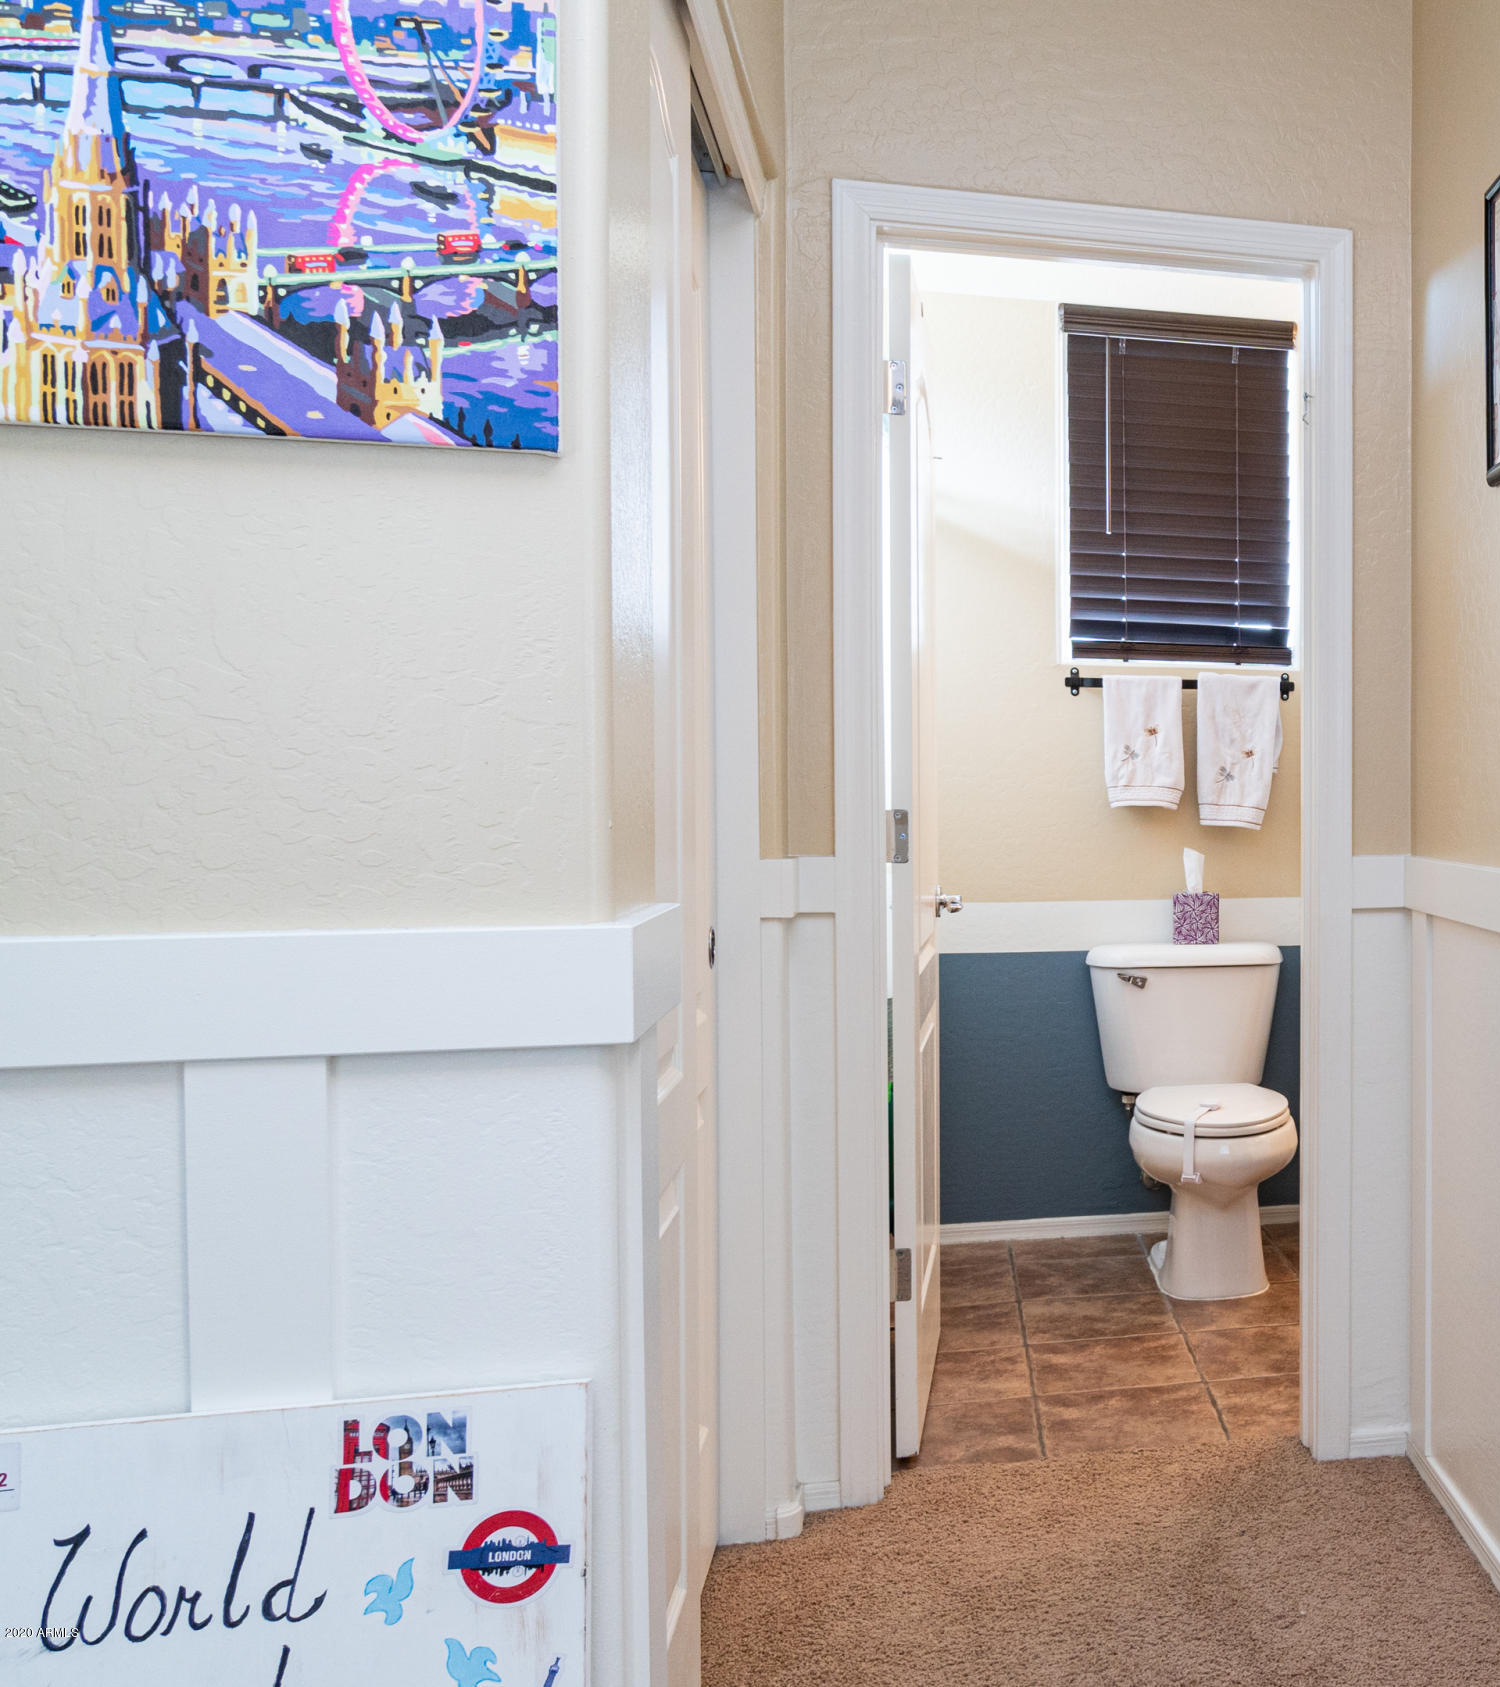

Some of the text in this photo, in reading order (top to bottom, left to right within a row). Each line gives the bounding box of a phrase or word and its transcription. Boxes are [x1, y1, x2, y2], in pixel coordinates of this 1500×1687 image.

[343, 1411, 467, 1465] LON
[334, 1456, 474, 1514] DON
[41, 1507, 327, 1652] World
[488, 1549, 532, 1563] LONDON
